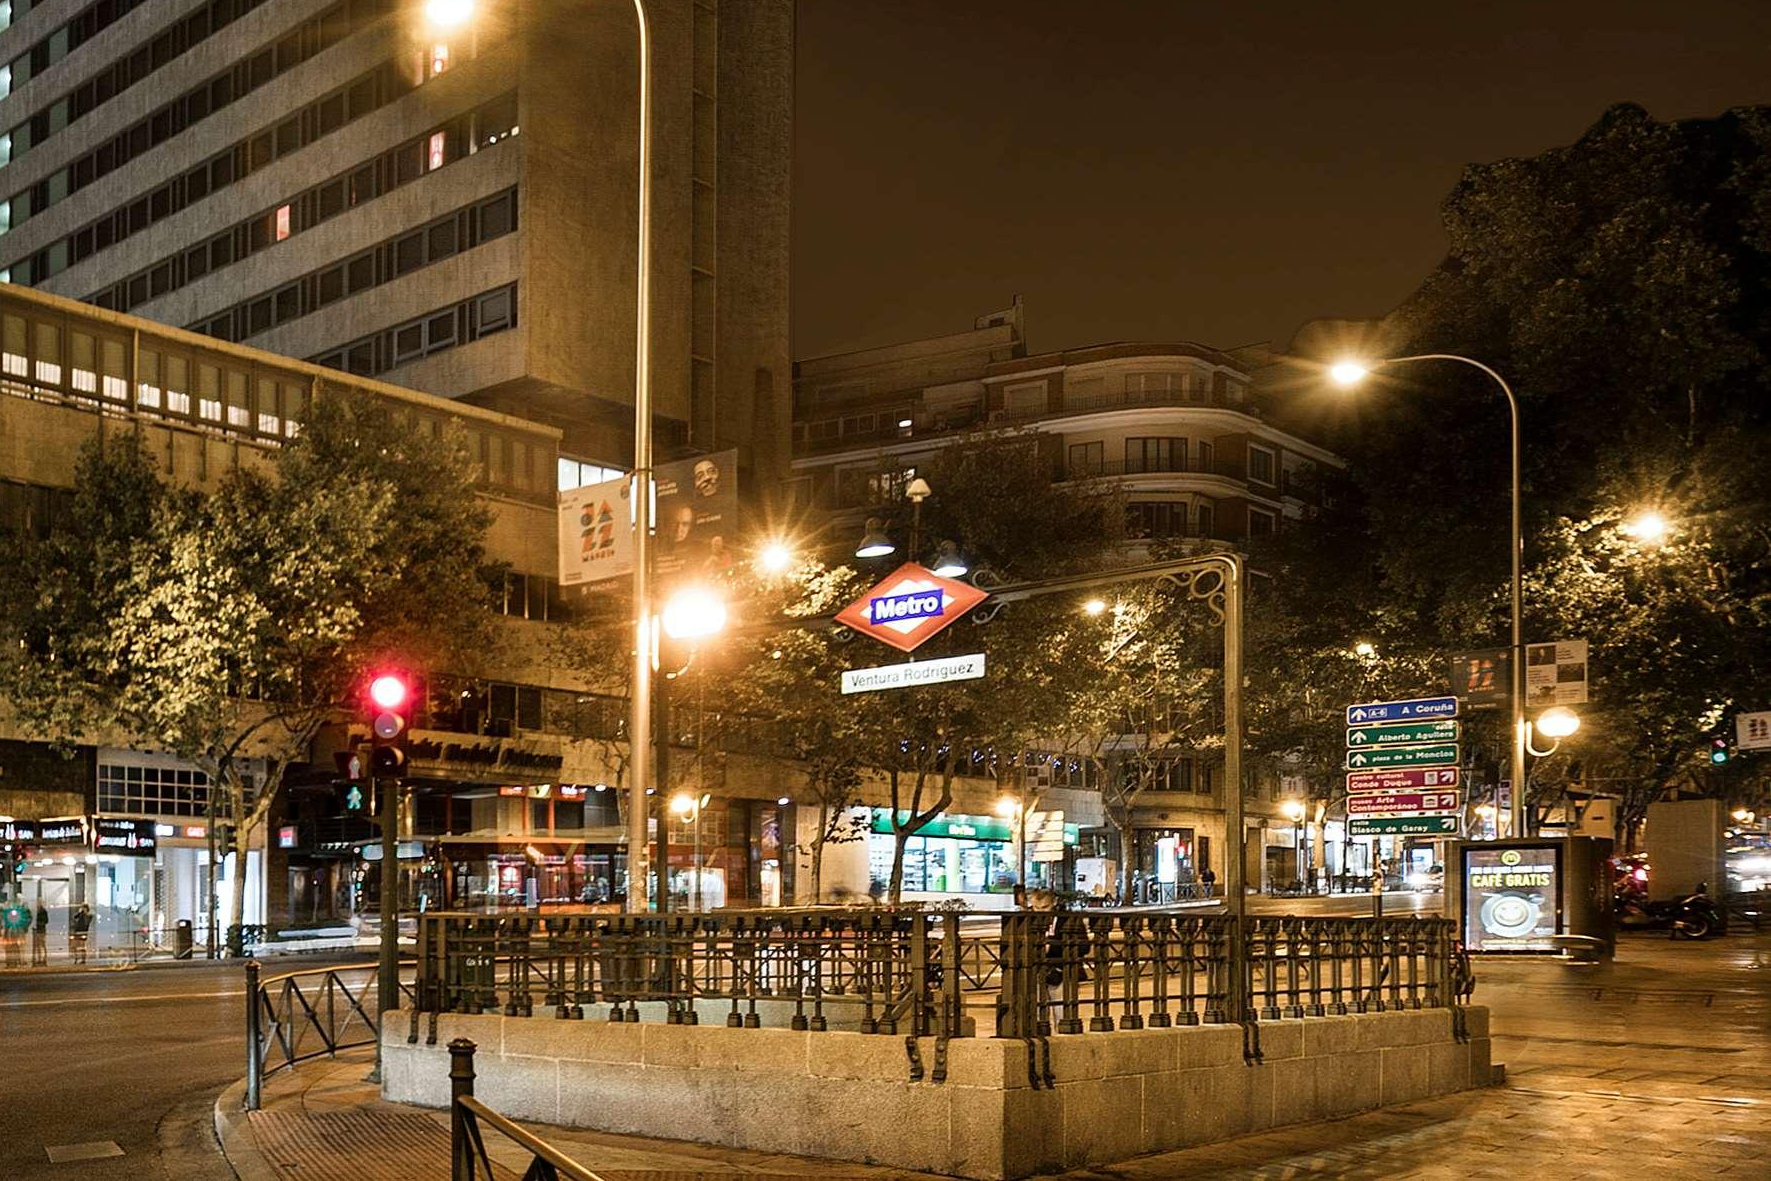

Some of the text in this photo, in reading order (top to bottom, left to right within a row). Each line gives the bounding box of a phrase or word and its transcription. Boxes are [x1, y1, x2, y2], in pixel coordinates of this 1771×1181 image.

[875, 595, 939, 620] Metro
[851, 674, 899, 687] Ventura
[1370, 703, 1454, 717] A-6 A Coruña
[1378, 731, 1454, 742] Alberto Aguilera
[1372, 754, 1391, 762] plaza
[1416, 750, 1454, 759] Moncloa
[1376, 772, 1405, 780] cultural
[1351, 780, 1412, 788] Conde Duque
[1376, 796, 1396, 804] Arte
[1351, 803, 1418, 812] Contemporáneo
[1351, 826, 1381, 834] Blasco
[1401, 825, 1429, 833] Garay
[1472, 873, 1550, 887] CAFÉ GRATIS
